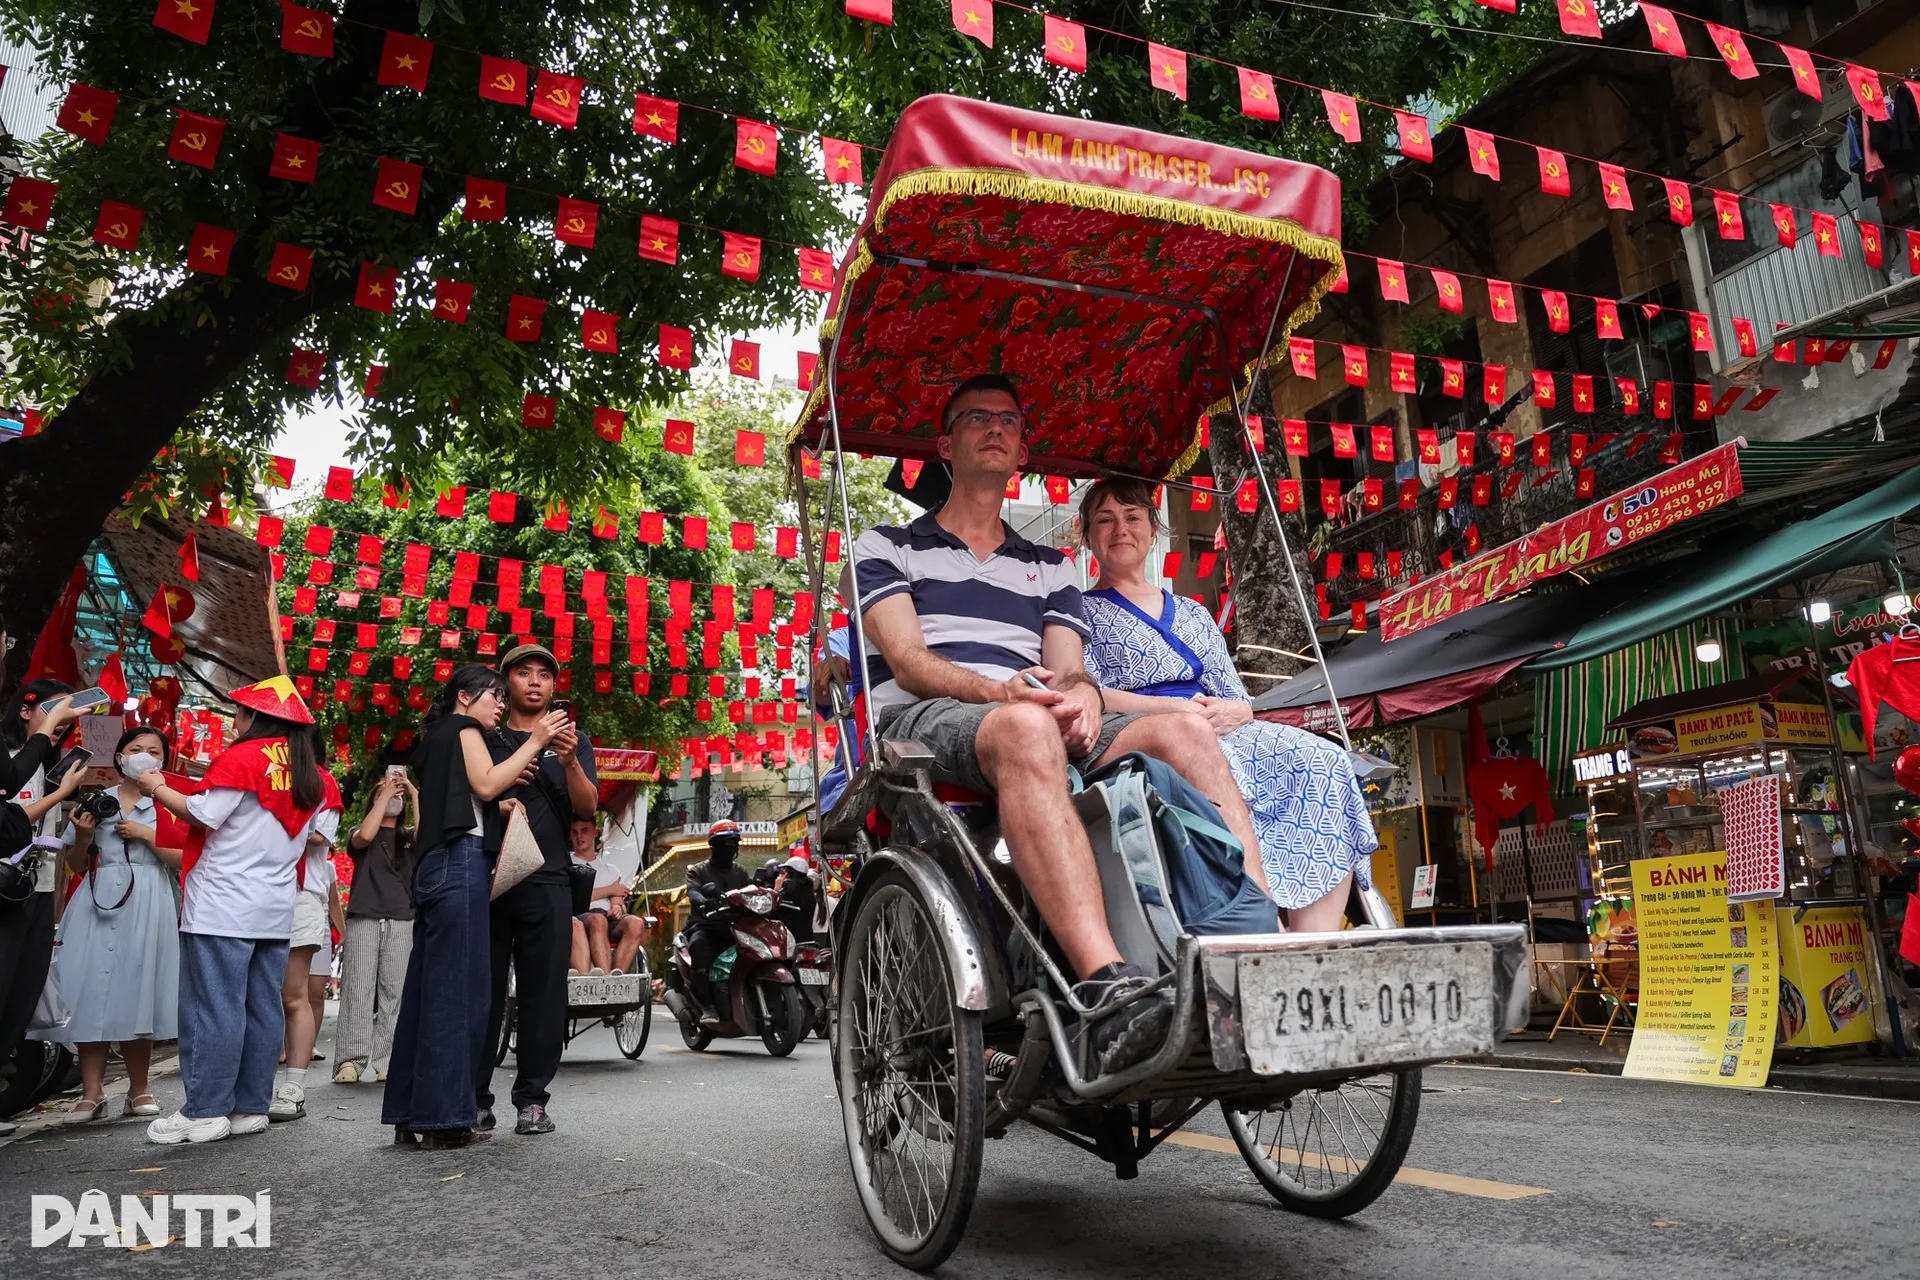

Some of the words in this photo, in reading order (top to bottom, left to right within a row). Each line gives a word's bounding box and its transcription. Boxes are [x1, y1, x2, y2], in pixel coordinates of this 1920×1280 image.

[1830, 82, 1844, 95] LG
[1011, 128, 1063, 163] LAM
[1070, 138, 1120, 170] ANH
[1623, 488, 1658, 515] 50
[1660, 477, 1695, 498] Hàng
[1626, 508, 1660, 528] 0912
[1664, 494, 1690, 512] 430
[1695, 480, 1723, 498] 169
[1628, 519, 1662, 540] 0989
[1666, 507, 1693, 524] 296
[1697, 493, 1725, 510] 972
[1460, 531, 1590, 598] Trang
[1679, 718, 1708, 736] BÁNH
[1711, 712, 1724, 731] MÌ
[1778, 708, 1799, 723] BÁNH
[1572, 753, 1614, 782] TRANG
[1650, 863, 1708, 887] BÁNH
[1713, 863, 1728, 881] M
[1641, 894, 1656, 903] Trang
[1672, 891, 1680, 900] 50
[1803, 915, 1845, 949] BÁNH
[1830, 952, 1853, 964] TRANG
